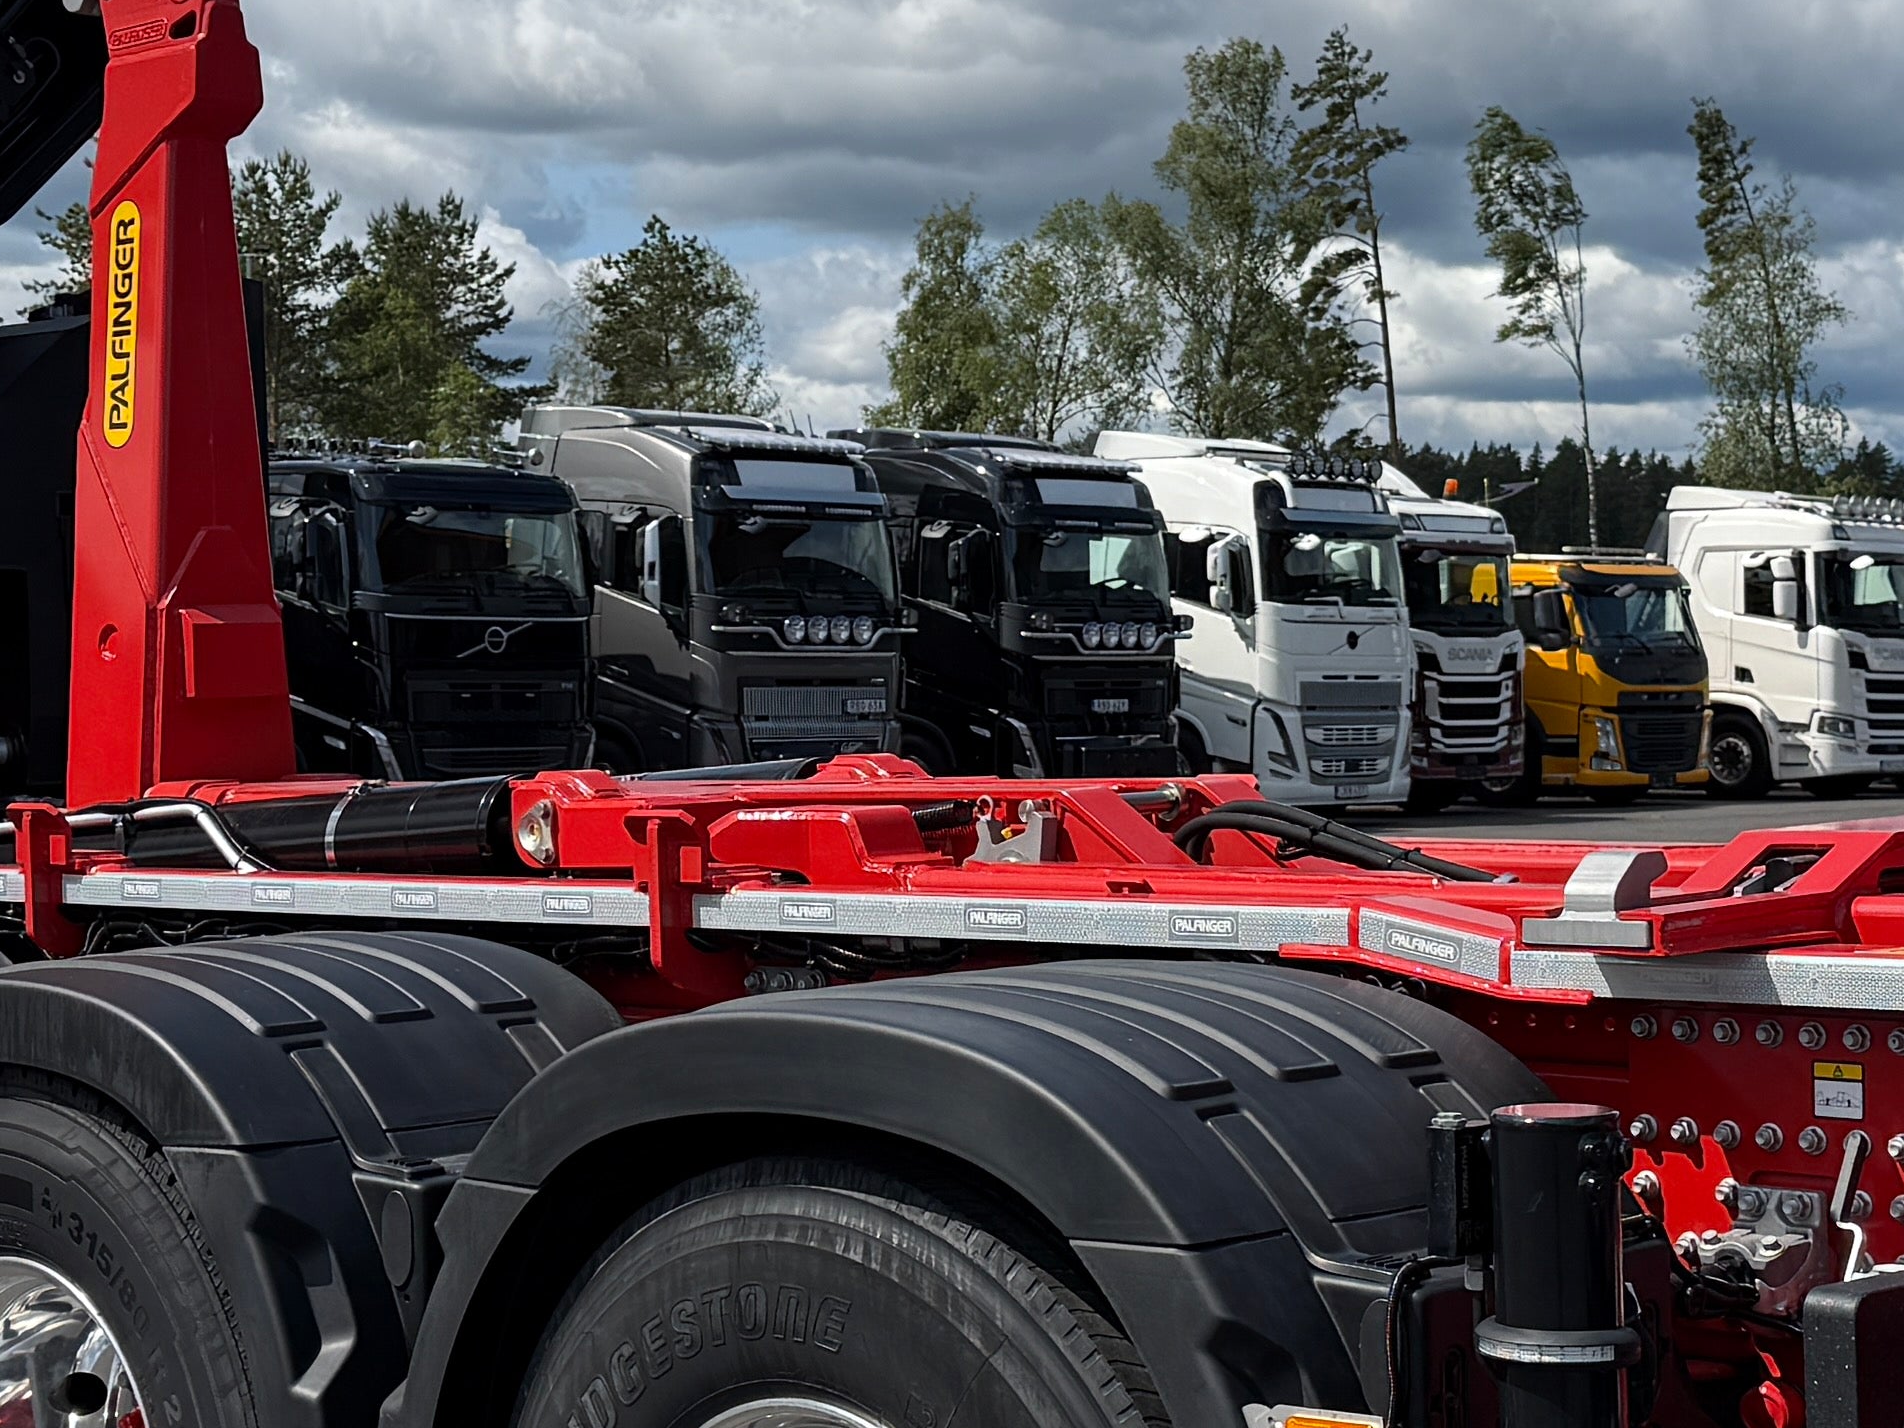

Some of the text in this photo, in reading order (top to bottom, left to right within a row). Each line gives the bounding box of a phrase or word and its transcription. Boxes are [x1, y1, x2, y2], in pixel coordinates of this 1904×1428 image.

[108, 217, 136, 430] PALFINGER
[1447, 647, 1494, 661] SCANIA
[969, 910, 1022, 926] PALFINGER
[1174, 918, 1232, 934] PALFINGER
[1391, 932, 1456, 961] PALFINGER
[69, 1212, 148, 1334] 315/80
